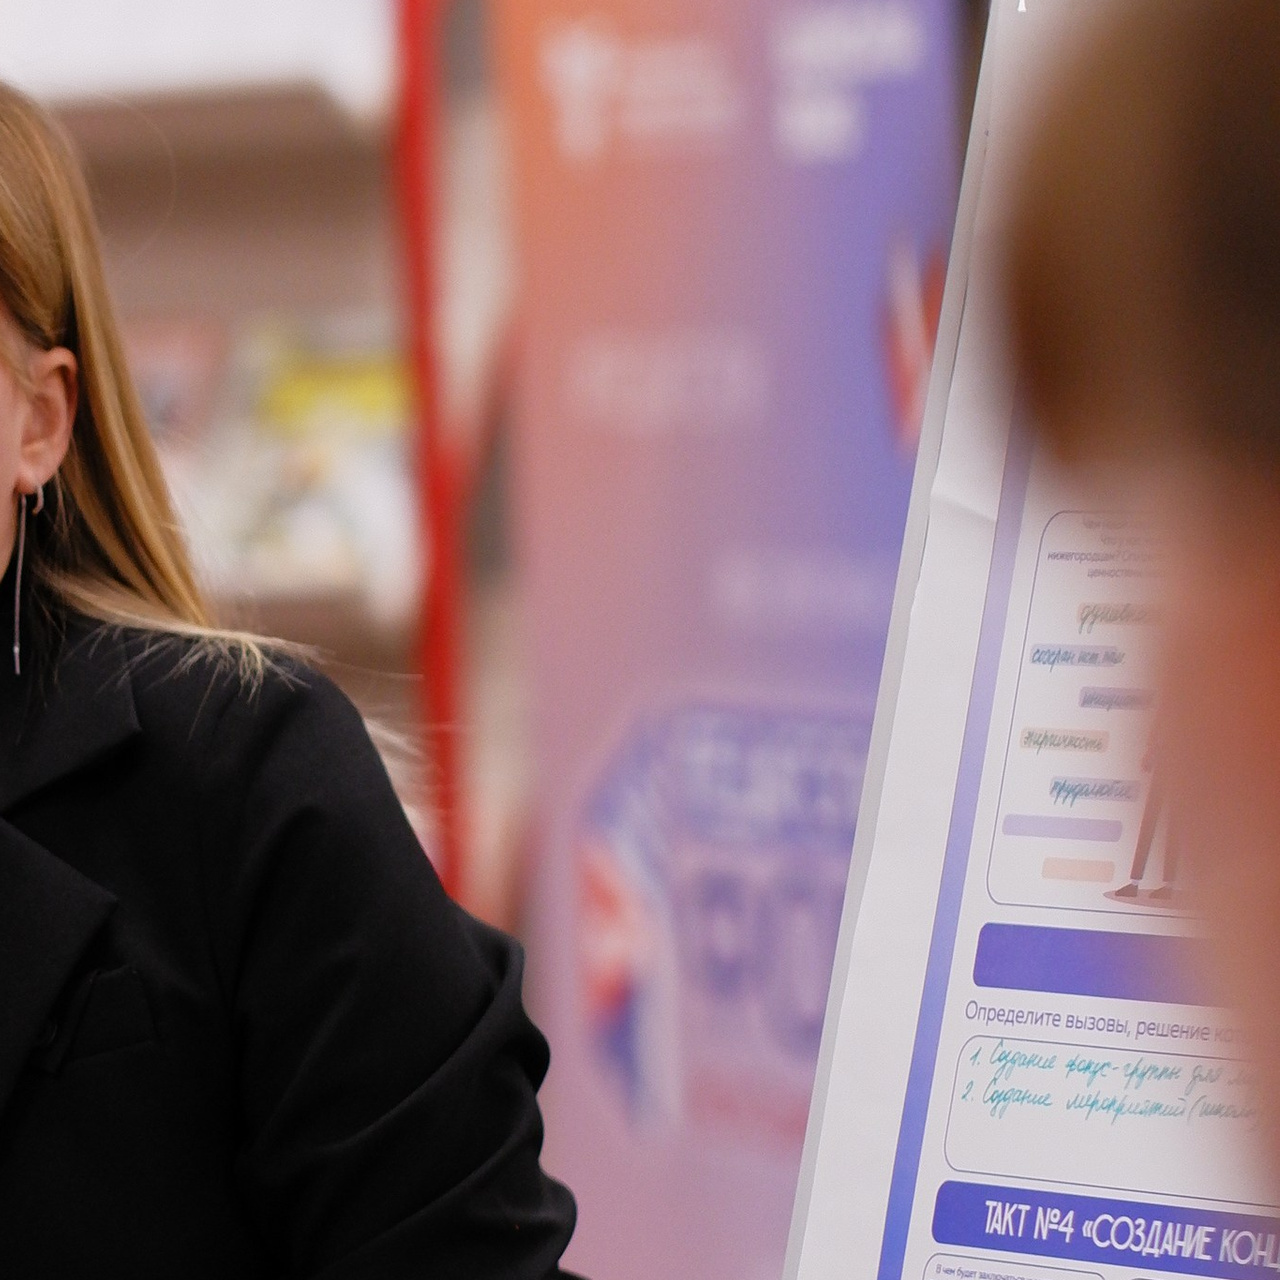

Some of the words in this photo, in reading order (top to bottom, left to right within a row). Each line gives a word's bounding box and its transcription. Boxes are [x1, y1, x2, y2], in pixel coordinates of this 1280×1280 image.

[965, 1000, 1062, 1027] Определите
[1065, 1014, 1131, 1037] вызовы,
[1135, 1021, 1211, 1041] решение
[970, 1046, 981, 1066] 1.
[990, 1038, 1058, 1081] Создание
[961, 1080, 975, 1101] 2.
[983, 1076, 1053, 1119] Создание
[985, 1200, 1030, 1238] ТАКТ
[1033, 1206, 1074, 1243] №4
[1082, 1213, 1216, 1261] «СОЗДАНИЕ
[957, 1267, 977, 1279] будет
